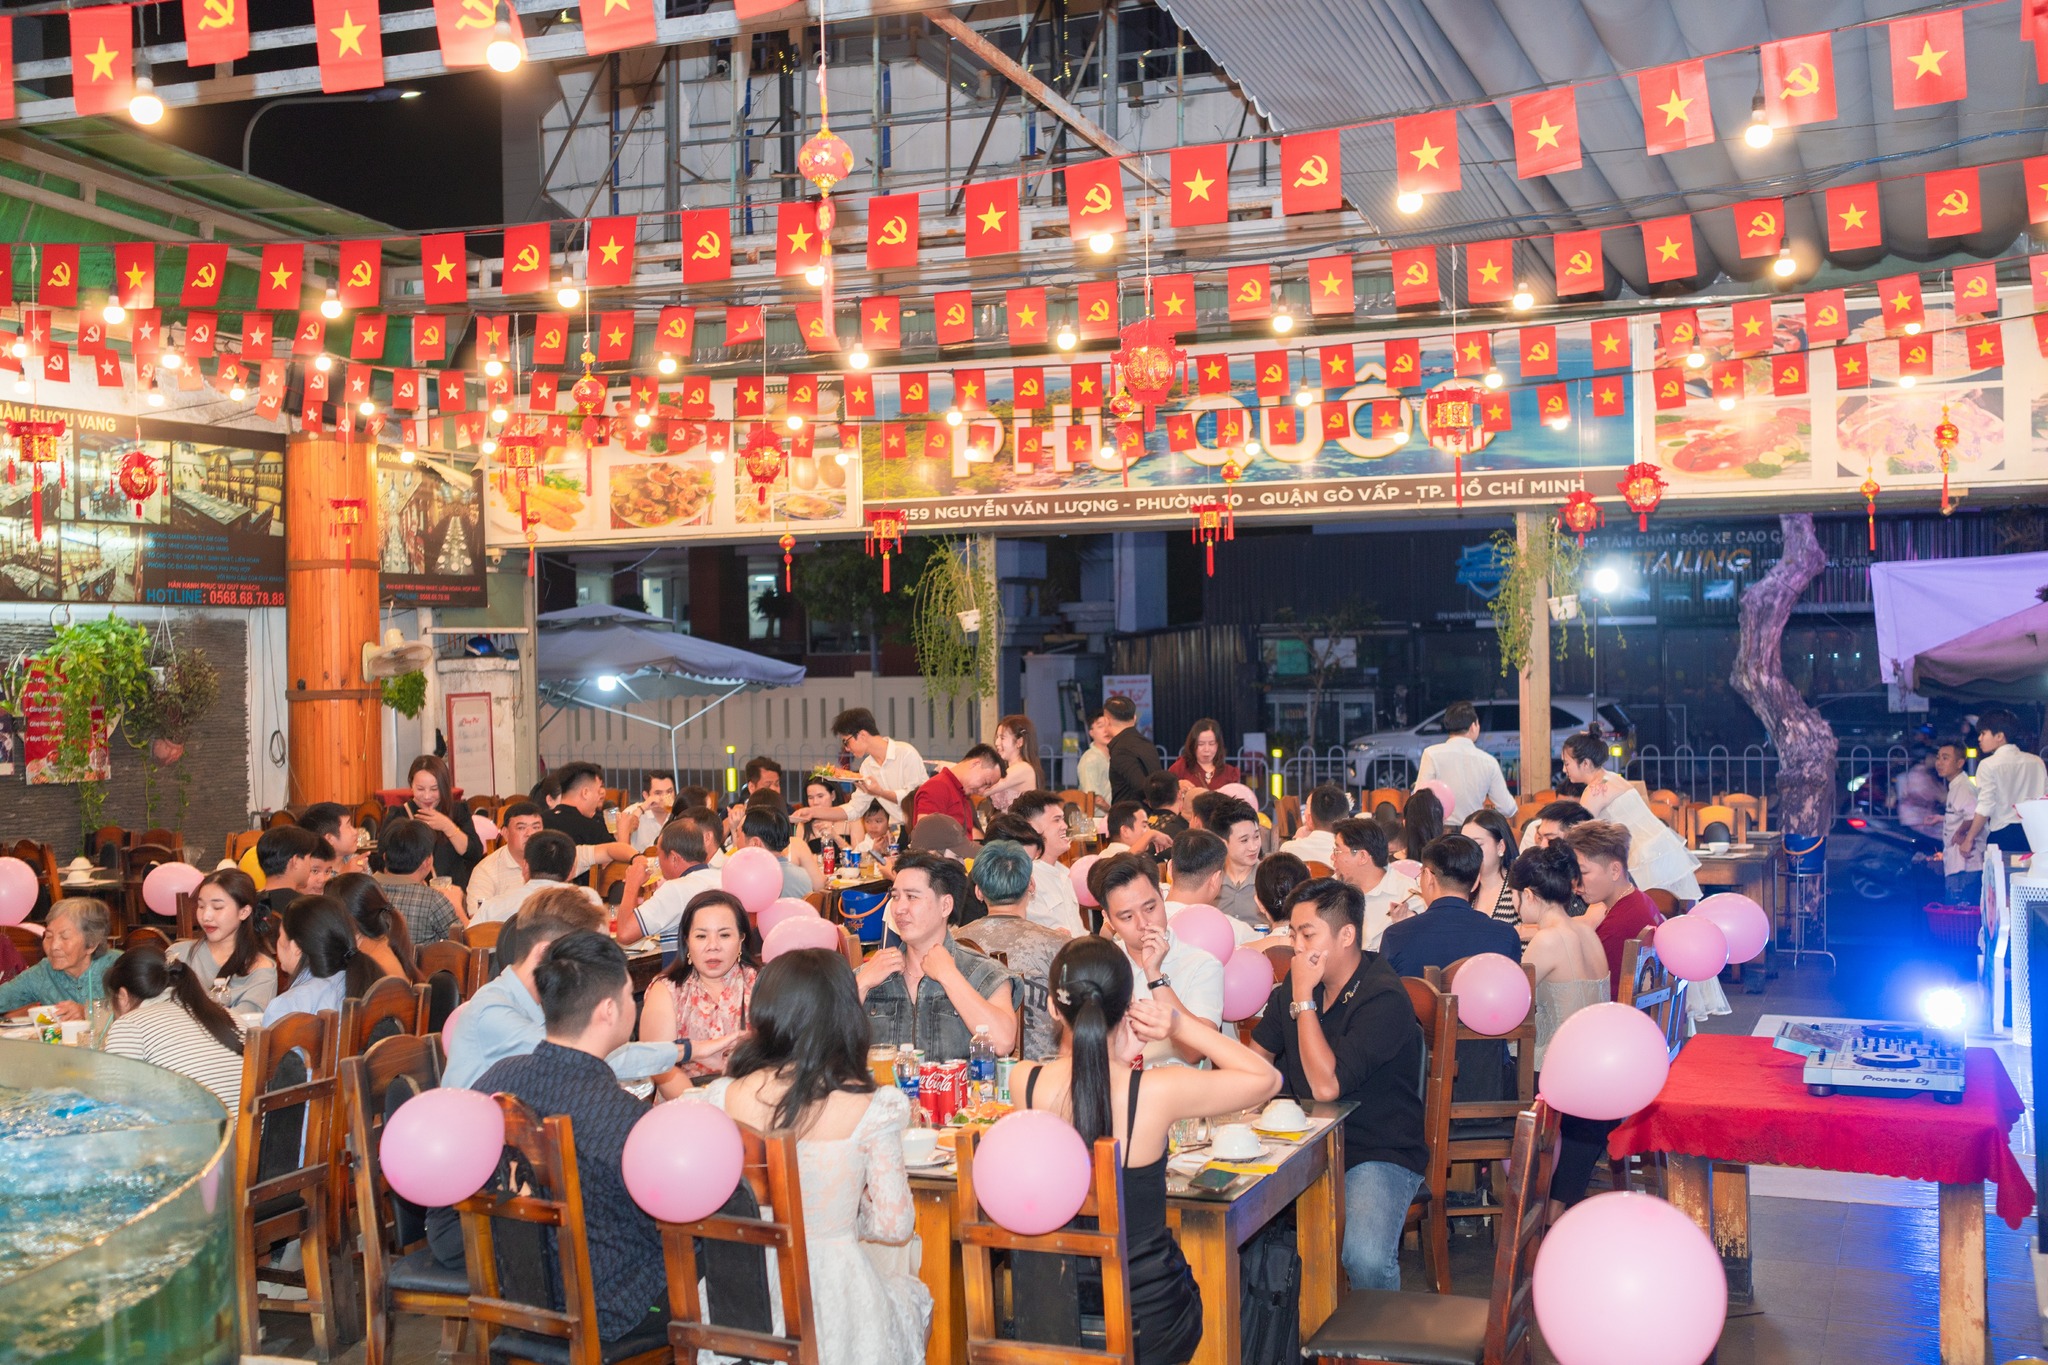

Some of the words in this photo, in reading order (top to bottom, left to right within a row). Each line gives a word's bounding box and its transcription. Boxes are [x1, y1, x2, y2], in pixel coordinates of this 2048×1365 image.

[78, 413, 117, 432] VANG
[900, 507, 929, 521] 259
[935, 499, 1008, 519] NGUYỄN
[1011, 500, 1049, 516] VĂN
[1054, 499, 1119, 516] LƯỢNG
[1260, 488, 1318, 507] QUẬN
[1323, 485, 1354, 503] GÒ
[1358, 482, 1400, 501] VẤP
[1416, 485, 1446, 499] TP.
[1488, 478, 1525, 495] CHÍ
[1531, 478, 1585, 494] MINH
[1713, 531, 1732, 543] XE
[1736, 530, 1767, 543] CAO
[146, 588, 207, 605] HOTLINE:
[209, 590, 285, 605] 0568.68.78.88
[1862, 1074, 1912, 1084] Pioneer
